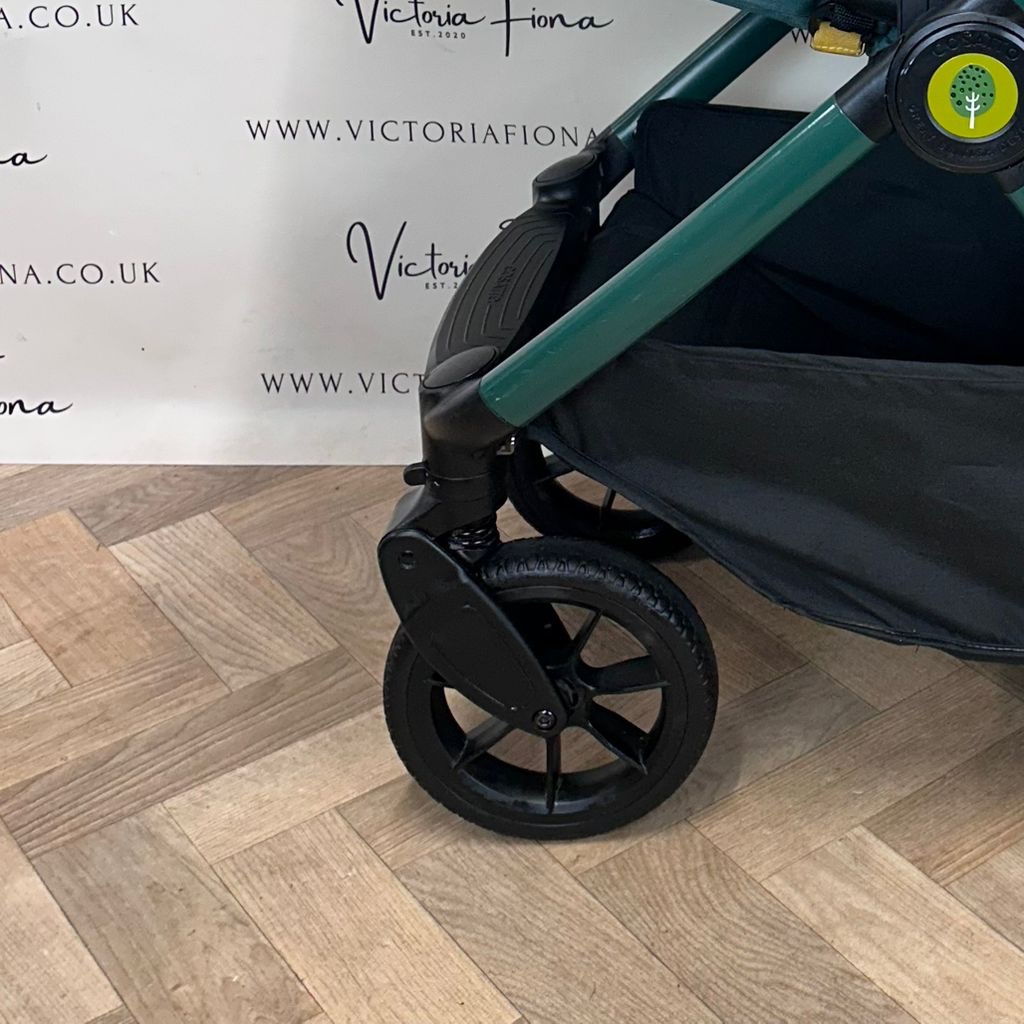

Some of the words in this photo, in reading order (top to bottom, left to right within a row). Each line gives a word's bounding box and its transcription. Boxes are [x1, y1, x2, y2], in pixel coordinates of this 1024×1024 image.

[411, 29, 467, 39] EST.2020
[346, 221, 475, 301] Victori
[425, 282, 458, 290] EST.2
